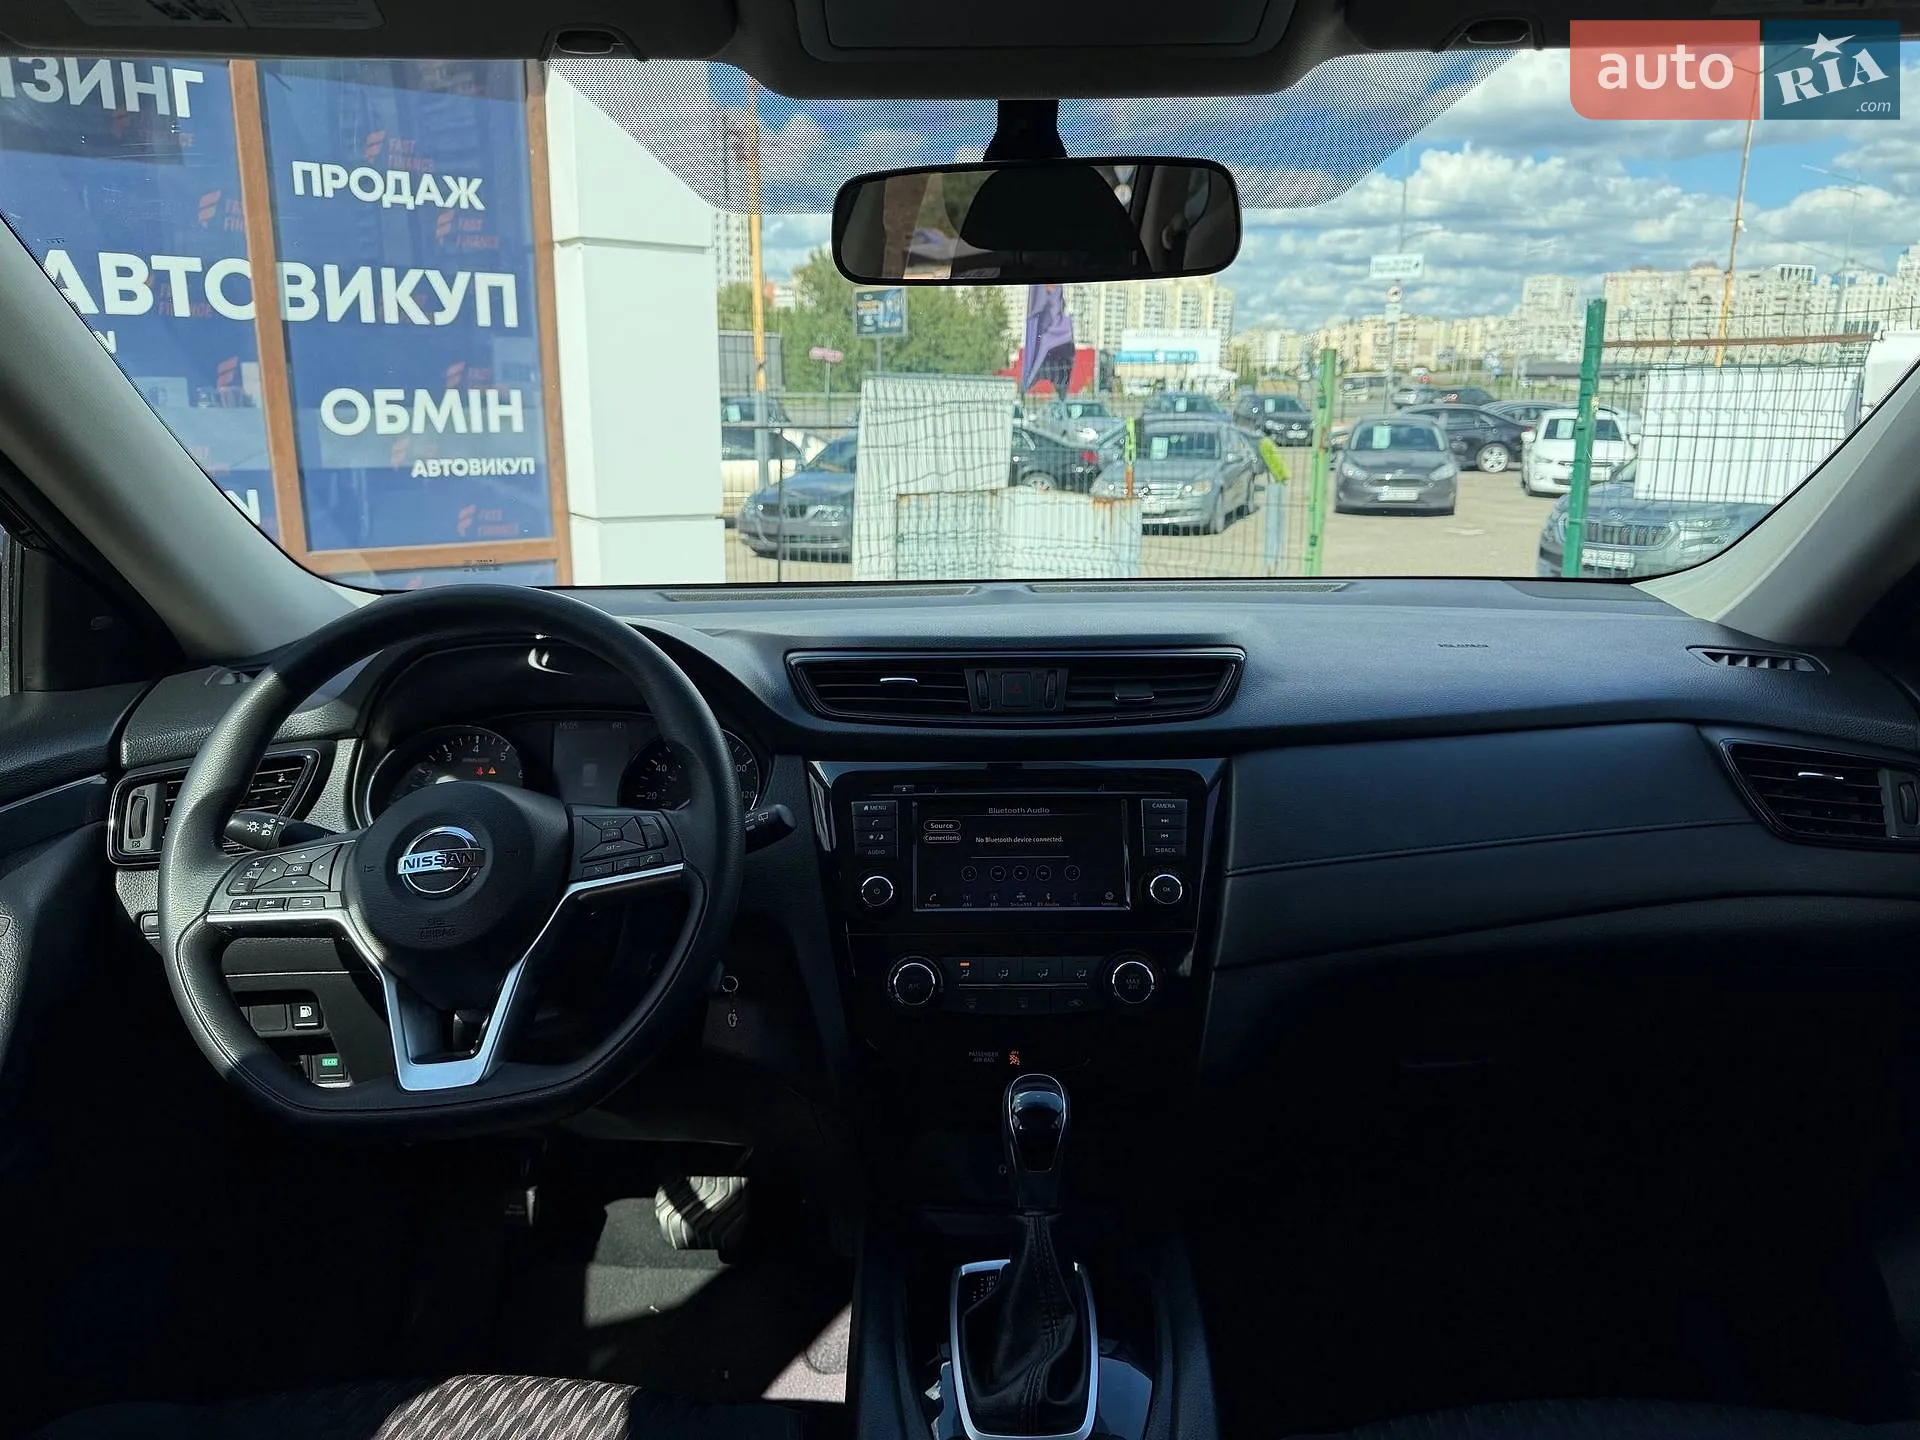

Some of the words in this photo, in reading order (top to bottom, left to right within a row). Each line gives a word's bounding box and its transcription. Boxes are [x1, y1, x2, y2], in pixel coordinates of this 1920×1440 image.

[292, 160, 486, 211] ПРОДАЖ
[320, 387, 524, 436] ОБМІН
[411, 457, 536, 478] АВТОВИКУП
[472, 745, 480, 753] 4
[445, 752, 453, 762] 3
[500, 752, 507, 761] 5
[655, 764, 668, 772] 40
[645, 791, 658, 800] 20
[402, 851, 477, 871] NISSAN
